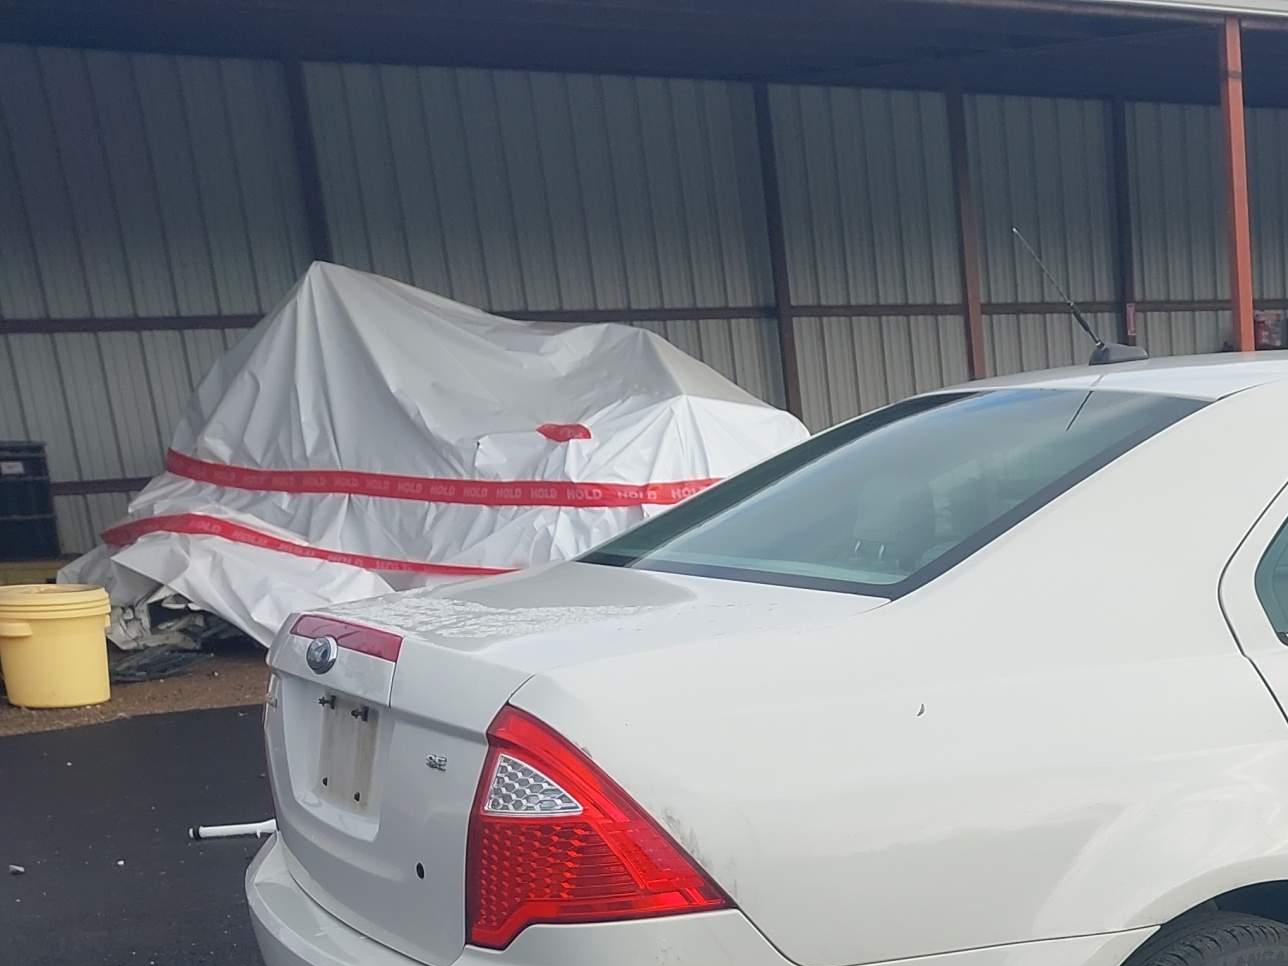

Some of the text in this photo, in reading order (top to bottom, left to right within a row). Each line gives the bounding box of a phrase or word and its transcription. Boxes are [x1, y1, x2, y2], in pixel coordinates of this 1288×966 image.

[430, 484, 456, 497] HOLD
[463, 486, 489, 498] HOLD
[496, 487, 522, 499] HOLD
[530, 487, 558, 500] HOLD
[566, 488, 603, 501] HOLD
[426, 754, 447, 772] SE
